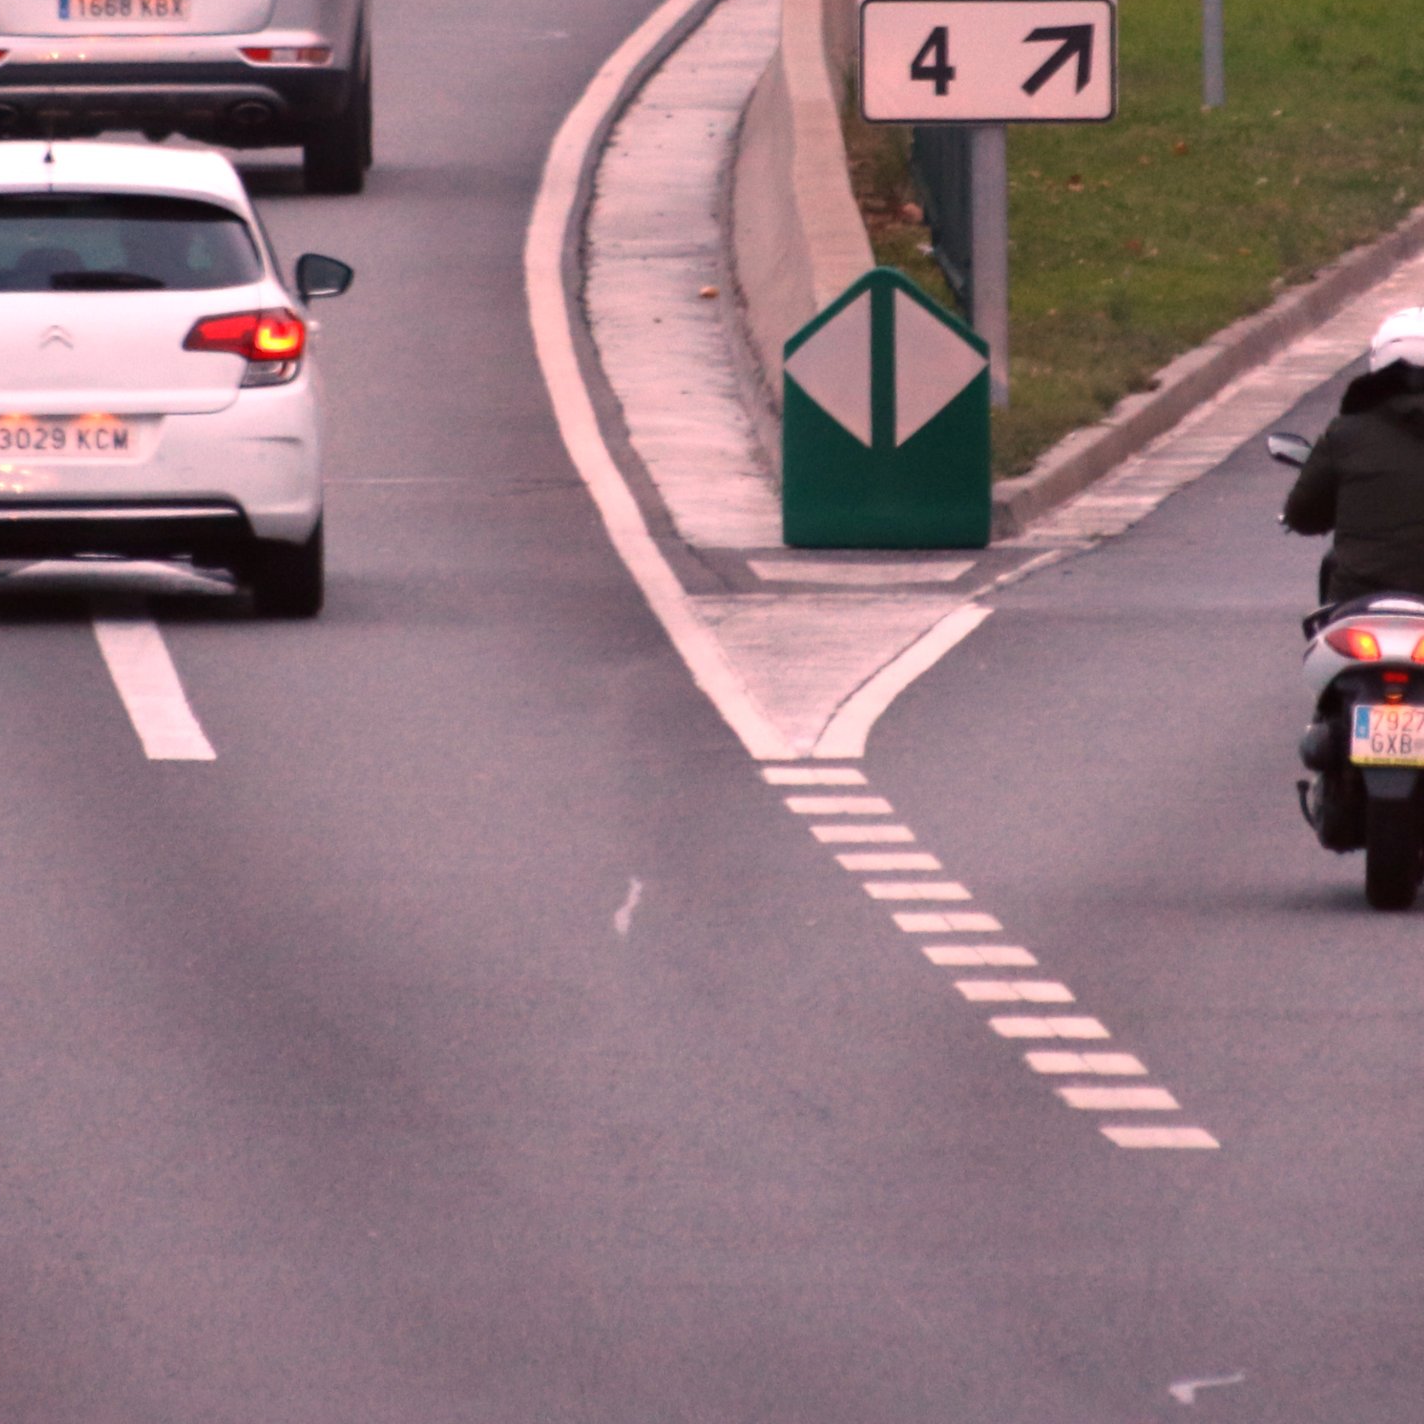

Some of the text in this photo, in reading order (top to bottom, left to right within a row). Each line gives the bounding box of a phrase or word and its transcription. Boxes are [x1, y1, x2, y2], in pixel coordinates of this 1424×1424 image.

[910, 26, 956, 96] 4
[77, 427, 129, 450] KCM
[1371, 732, 1412, 755] GXB
